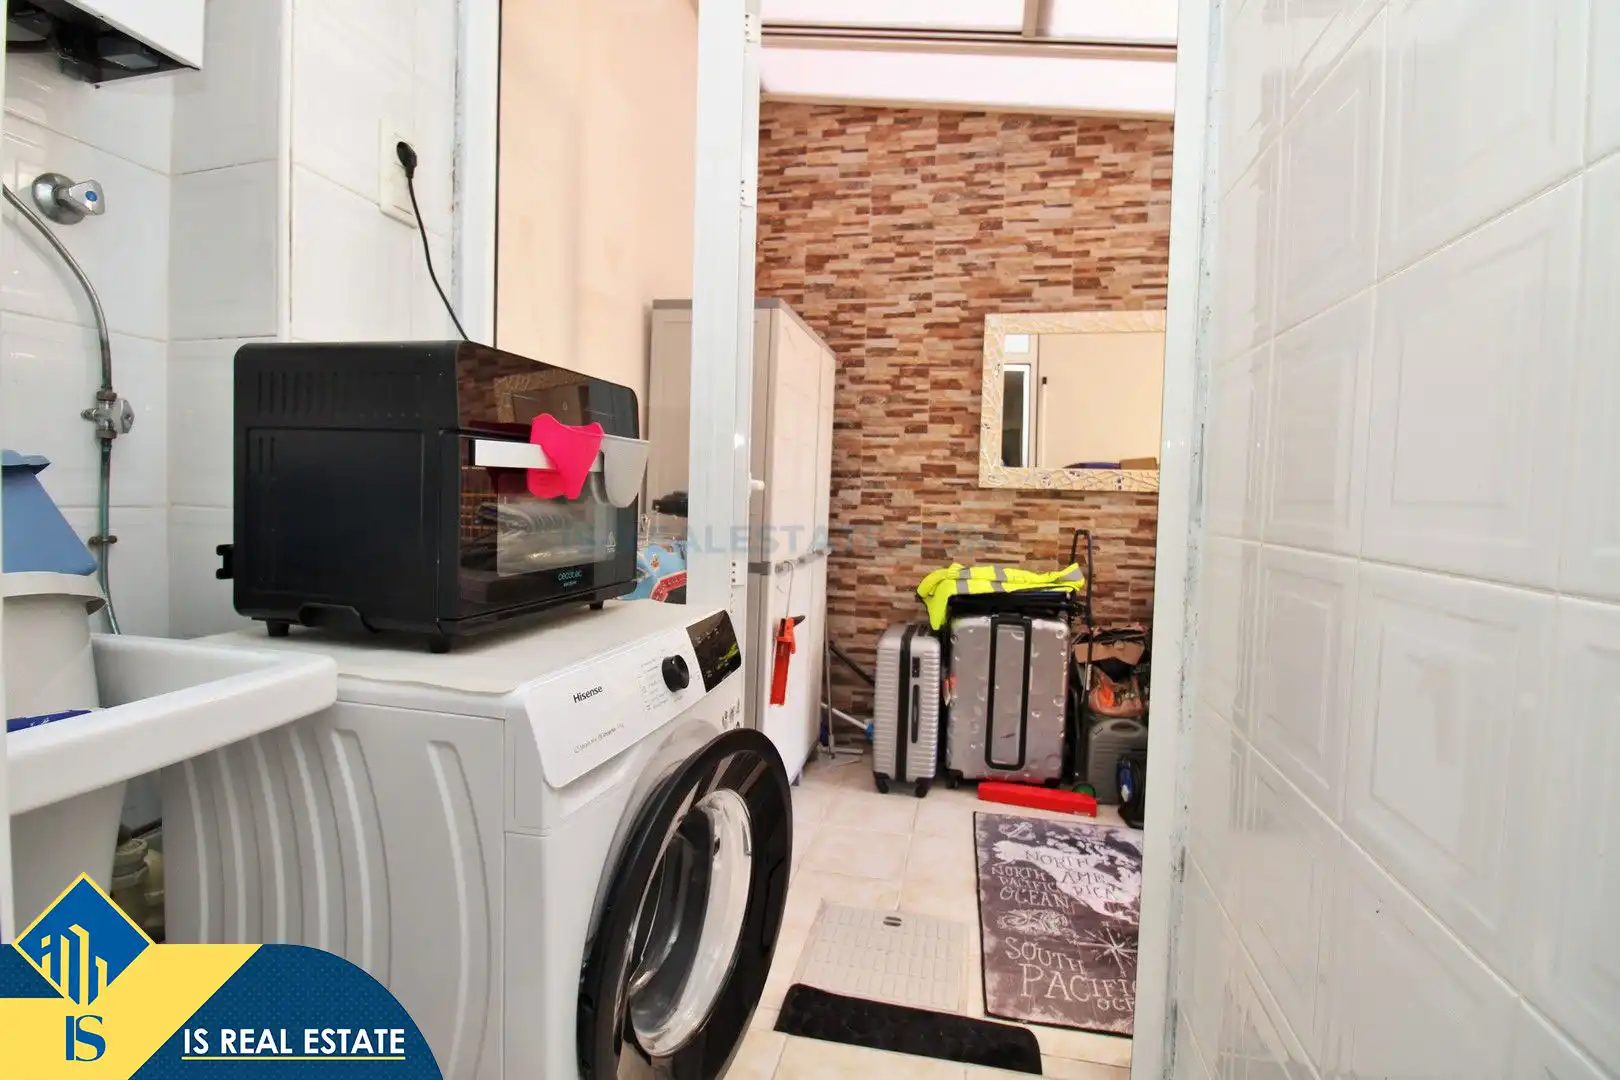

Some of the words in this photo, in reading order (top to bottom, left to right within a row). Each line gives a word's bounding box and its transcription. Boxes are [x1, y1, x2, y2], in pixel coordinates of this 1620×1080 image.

[573, 686, 603, 703] Hisense
[1025, 850, 1090, 870] NORTH
[992, 865, 1046, 881] NORTH
[1000, 886, 1070, 908] OCEAN
[1005, 936, 1087, 976] SOUTH
